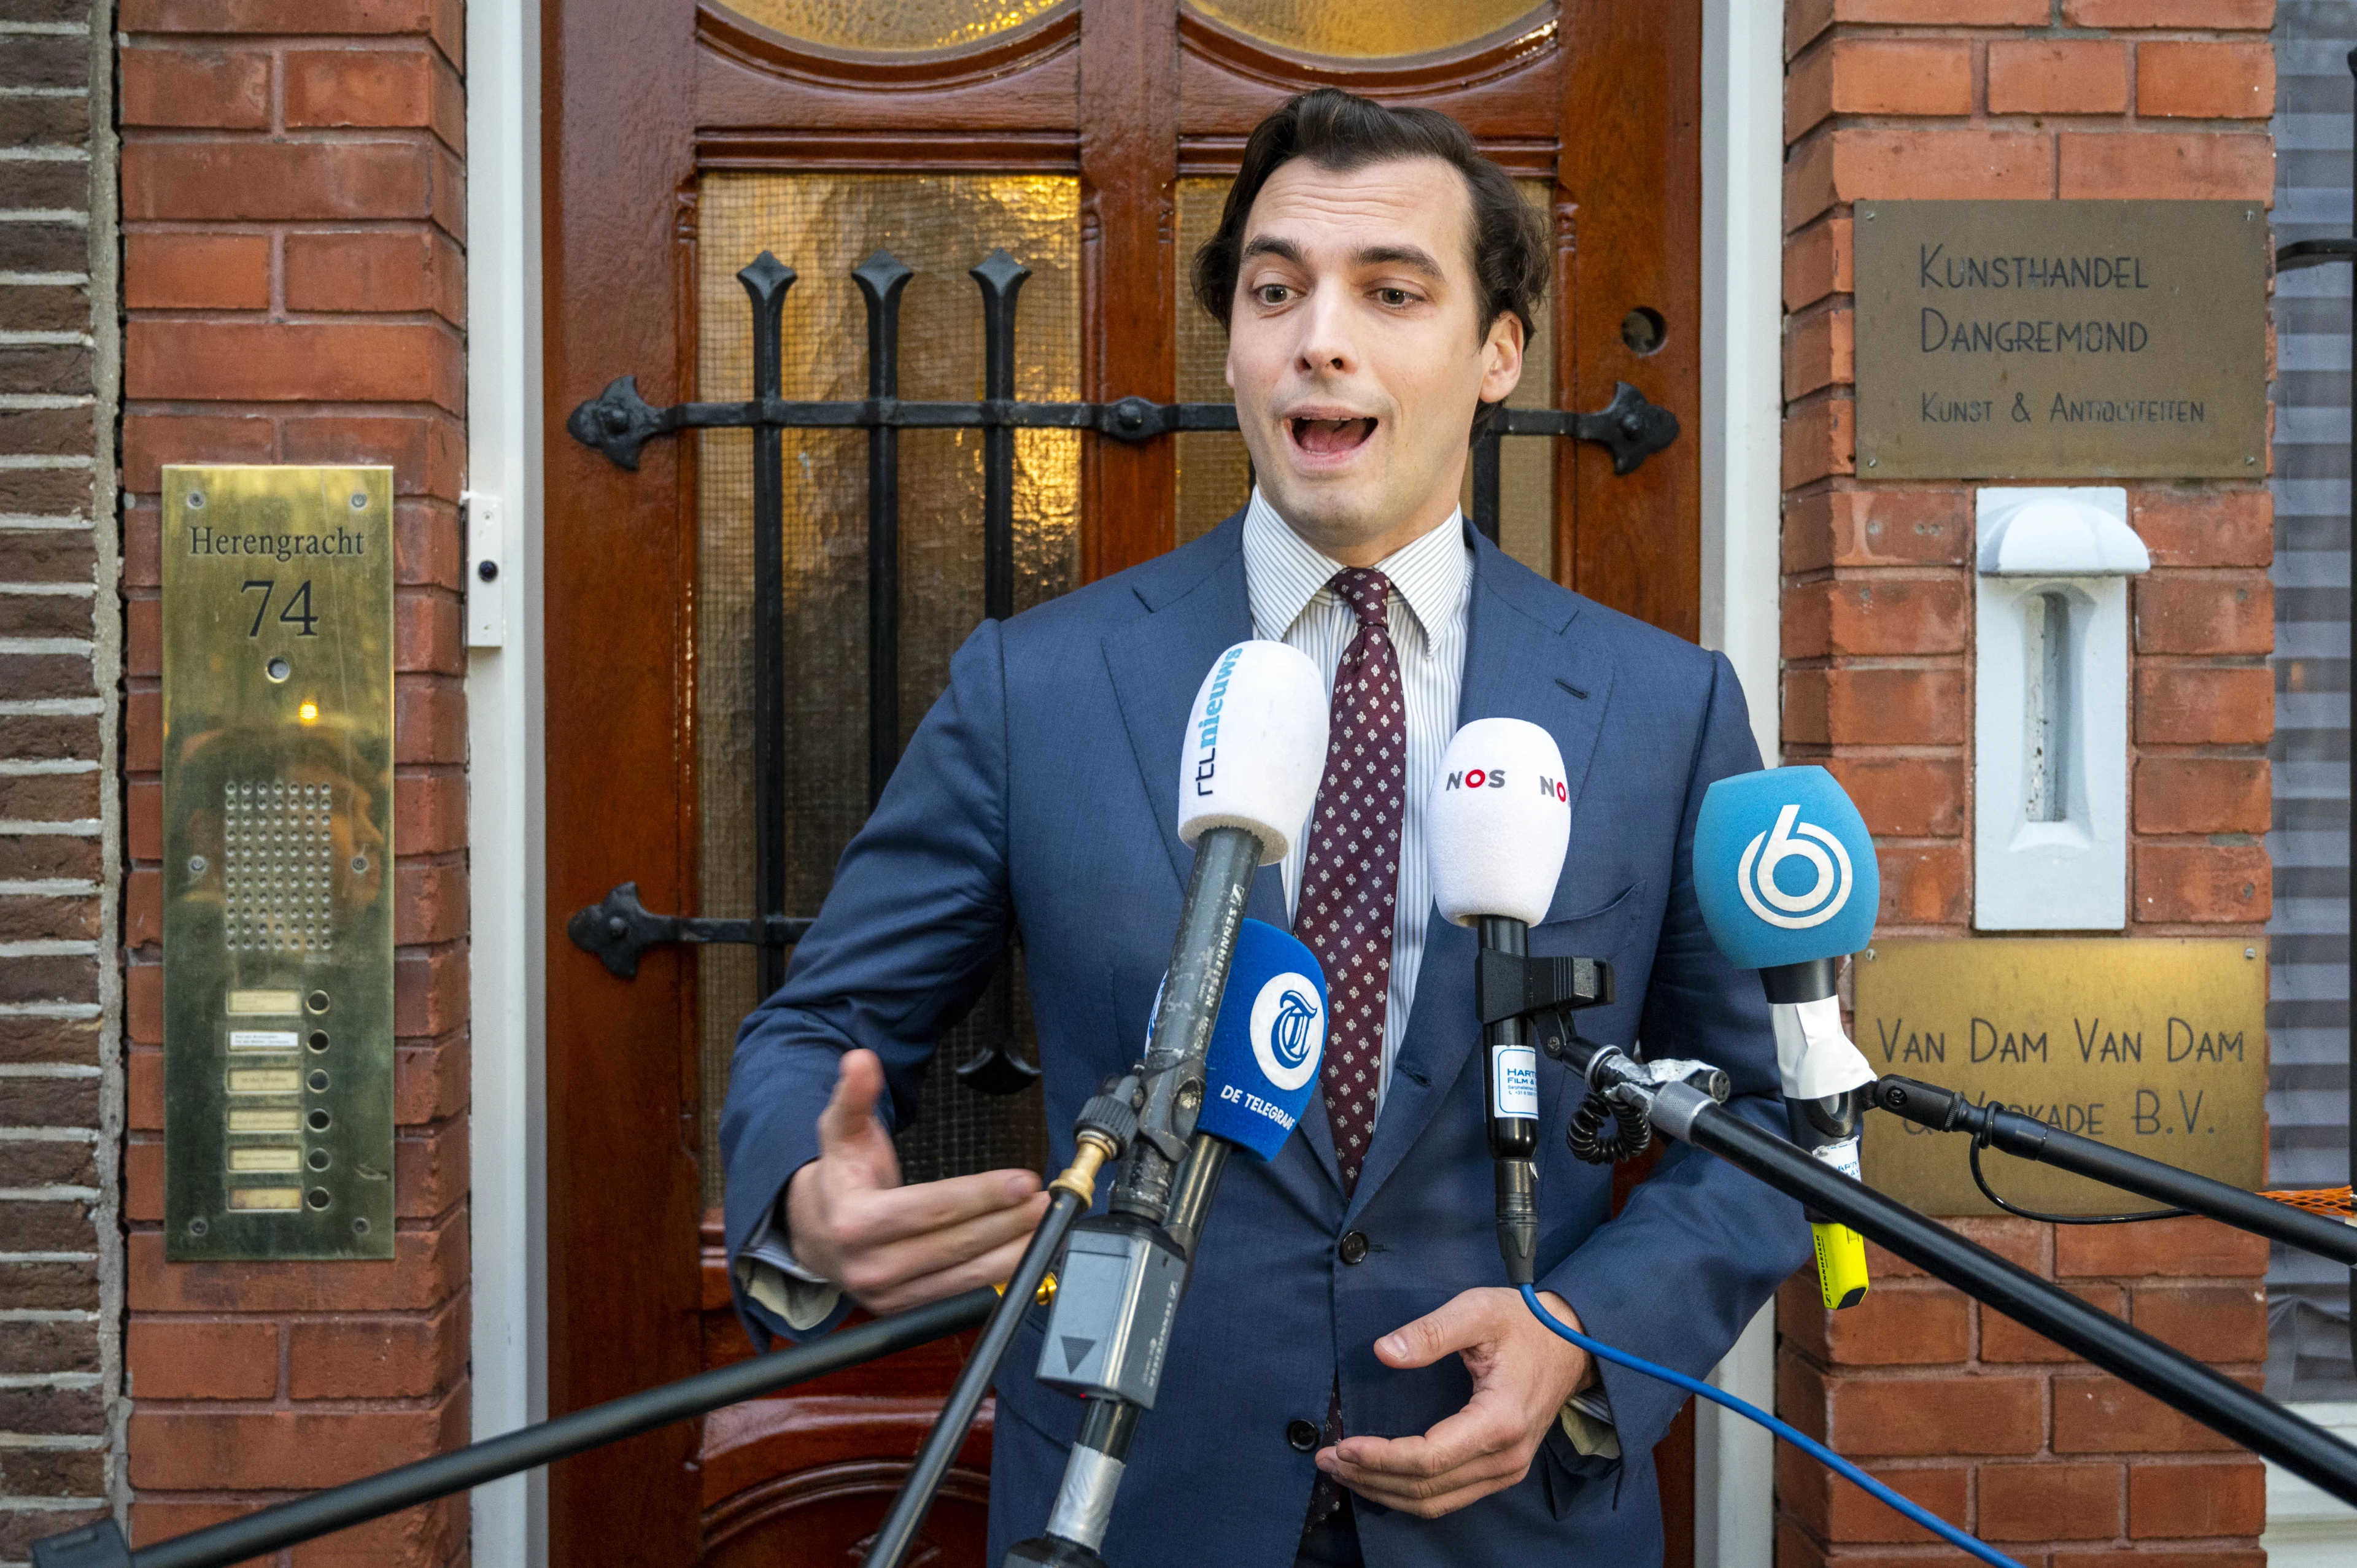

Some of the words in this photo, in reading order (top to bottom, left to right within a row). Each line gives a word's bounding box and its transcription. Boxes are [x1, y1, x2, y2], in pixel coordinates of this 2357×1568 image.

[2010, 392, 2032, 423] &
[190, 525, 365, 563] Herengracht
[240, 579, 319, 638] 74
[1446, 768, 1506, 791] NOS
[1754, 803, 1836, 914] 6
[1220, 1084, 1244, 1104] DE
[2132, 1089, 2216, 1135] B.V.
[1816, 1234, 1829, 1292] SENNHEISER
